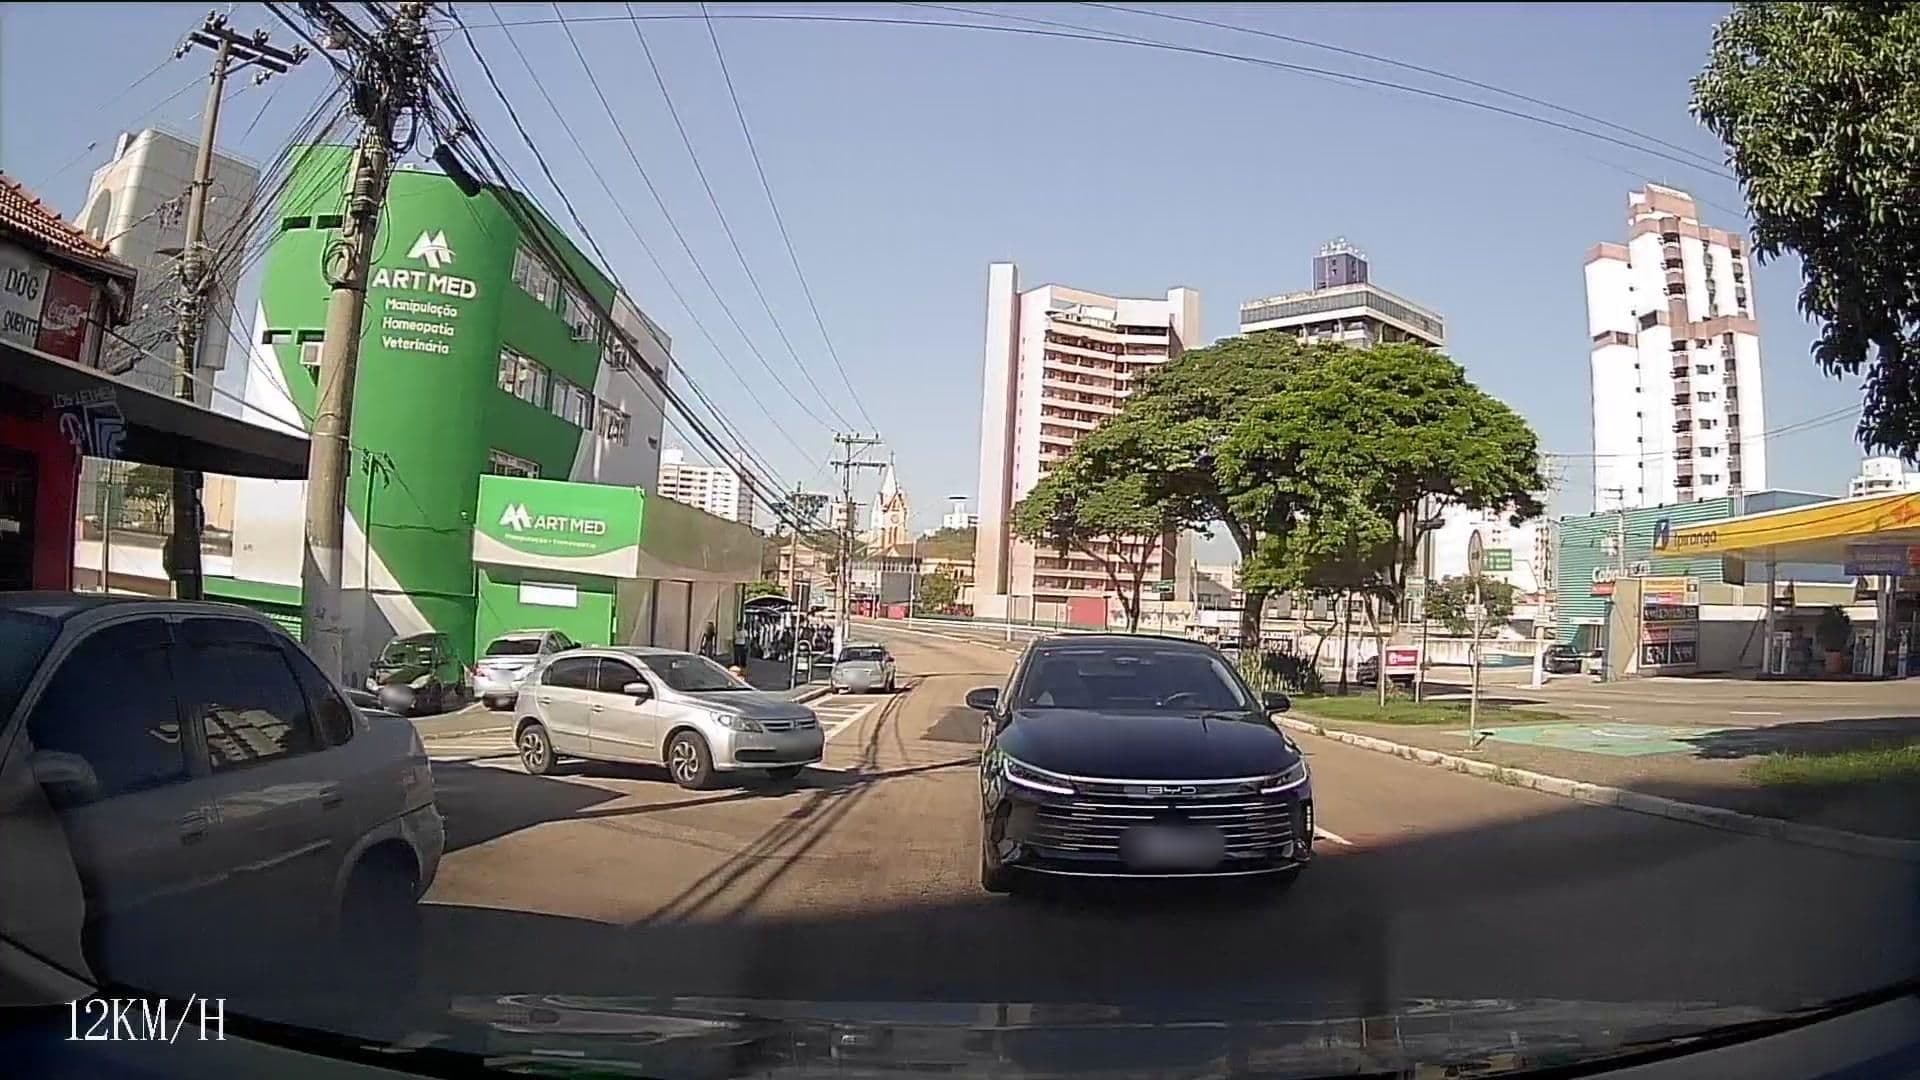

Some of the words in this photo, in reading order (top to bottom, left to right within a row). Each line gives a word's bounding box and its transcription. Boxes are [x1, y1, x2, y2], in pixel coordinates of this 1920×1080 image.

[5, 267, 39, 300] DOG
[372, 268, 425, 290] ART
[428, 273, 477, 299] MED
[385, 298, 458, 317] Manipulação
[382, 316, 455, 336] Homeopatia
[382, 336, 450, 354] Veterinária
[534, 515, 568, 532] ART
[570, 518, 606, 535] MED
[1147, 786, 1197, 794] BYD
